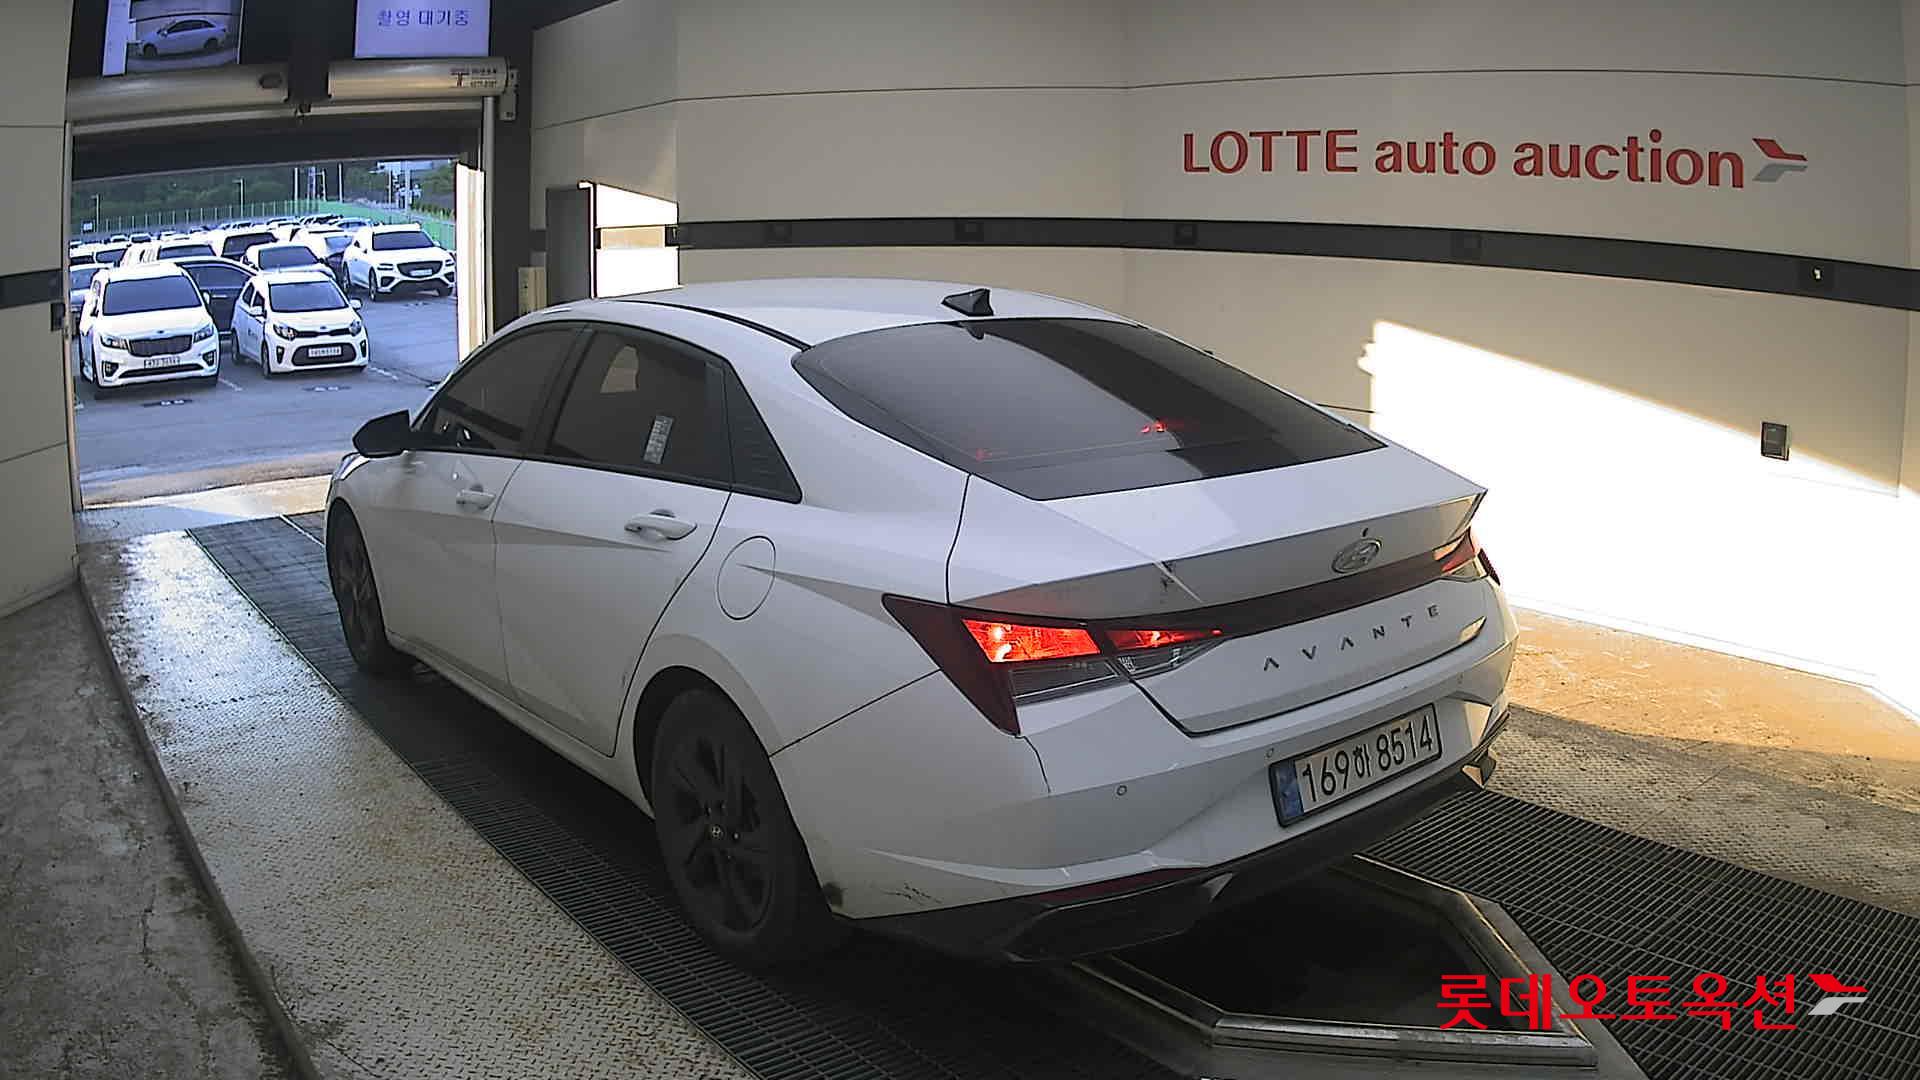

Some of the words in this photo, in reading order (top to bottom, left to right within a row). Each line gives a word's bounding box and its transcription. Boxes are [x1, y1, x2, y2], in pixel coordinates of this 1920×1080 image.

[418, 9, 470, 27] 대기중
[1184, 129, 1358, 173] LOTTE
[1375, 132, 1496, 176] auto
[1513, 129, 1744, 188] auction
[1264, 604, 1439, 671] AVANTE
[1376, 715, 1433, 771] 8514
